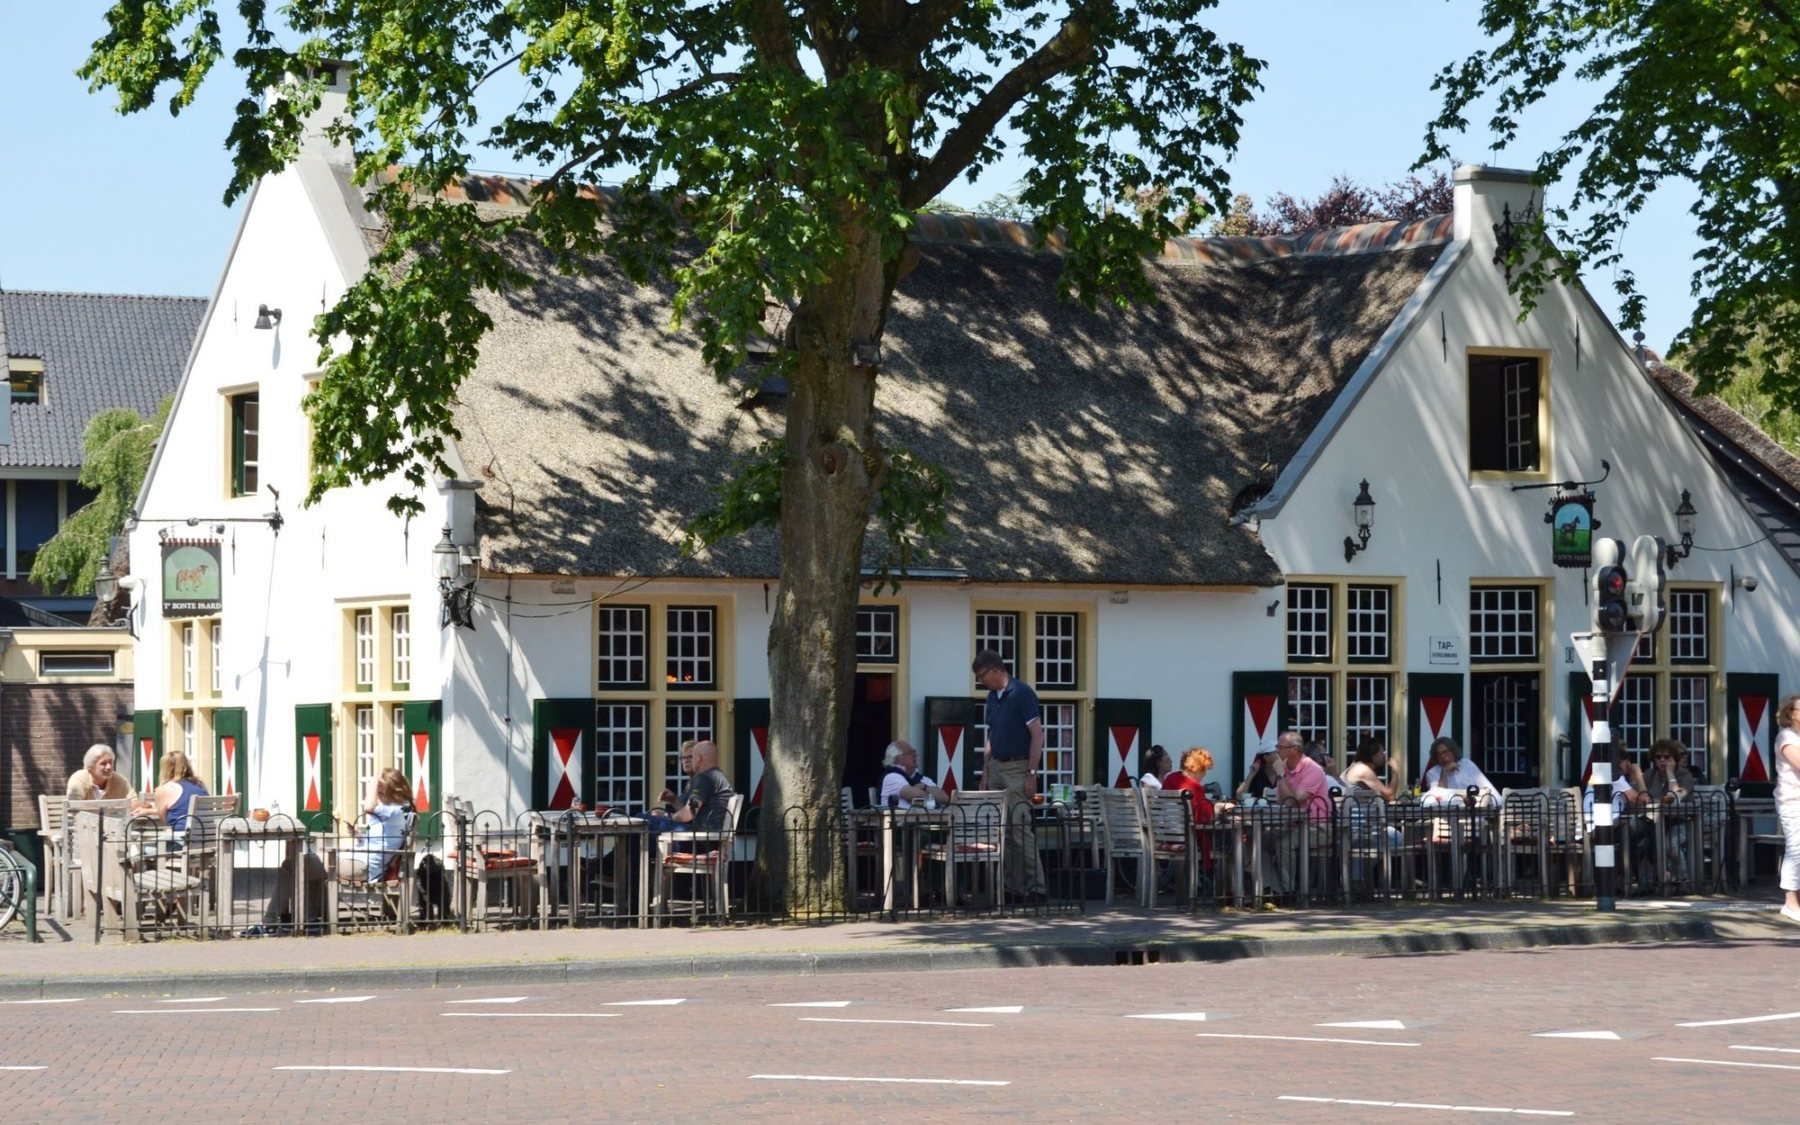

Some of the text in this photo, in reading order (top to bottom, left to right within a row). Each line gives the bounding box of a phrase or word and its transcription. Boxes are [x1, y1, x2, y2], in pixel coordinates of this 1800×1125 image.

[172, 602, 196, 610] BONTE
[197, 602, 222, 610] PAARD
[1437, 641, 1454, 650] TAP-
